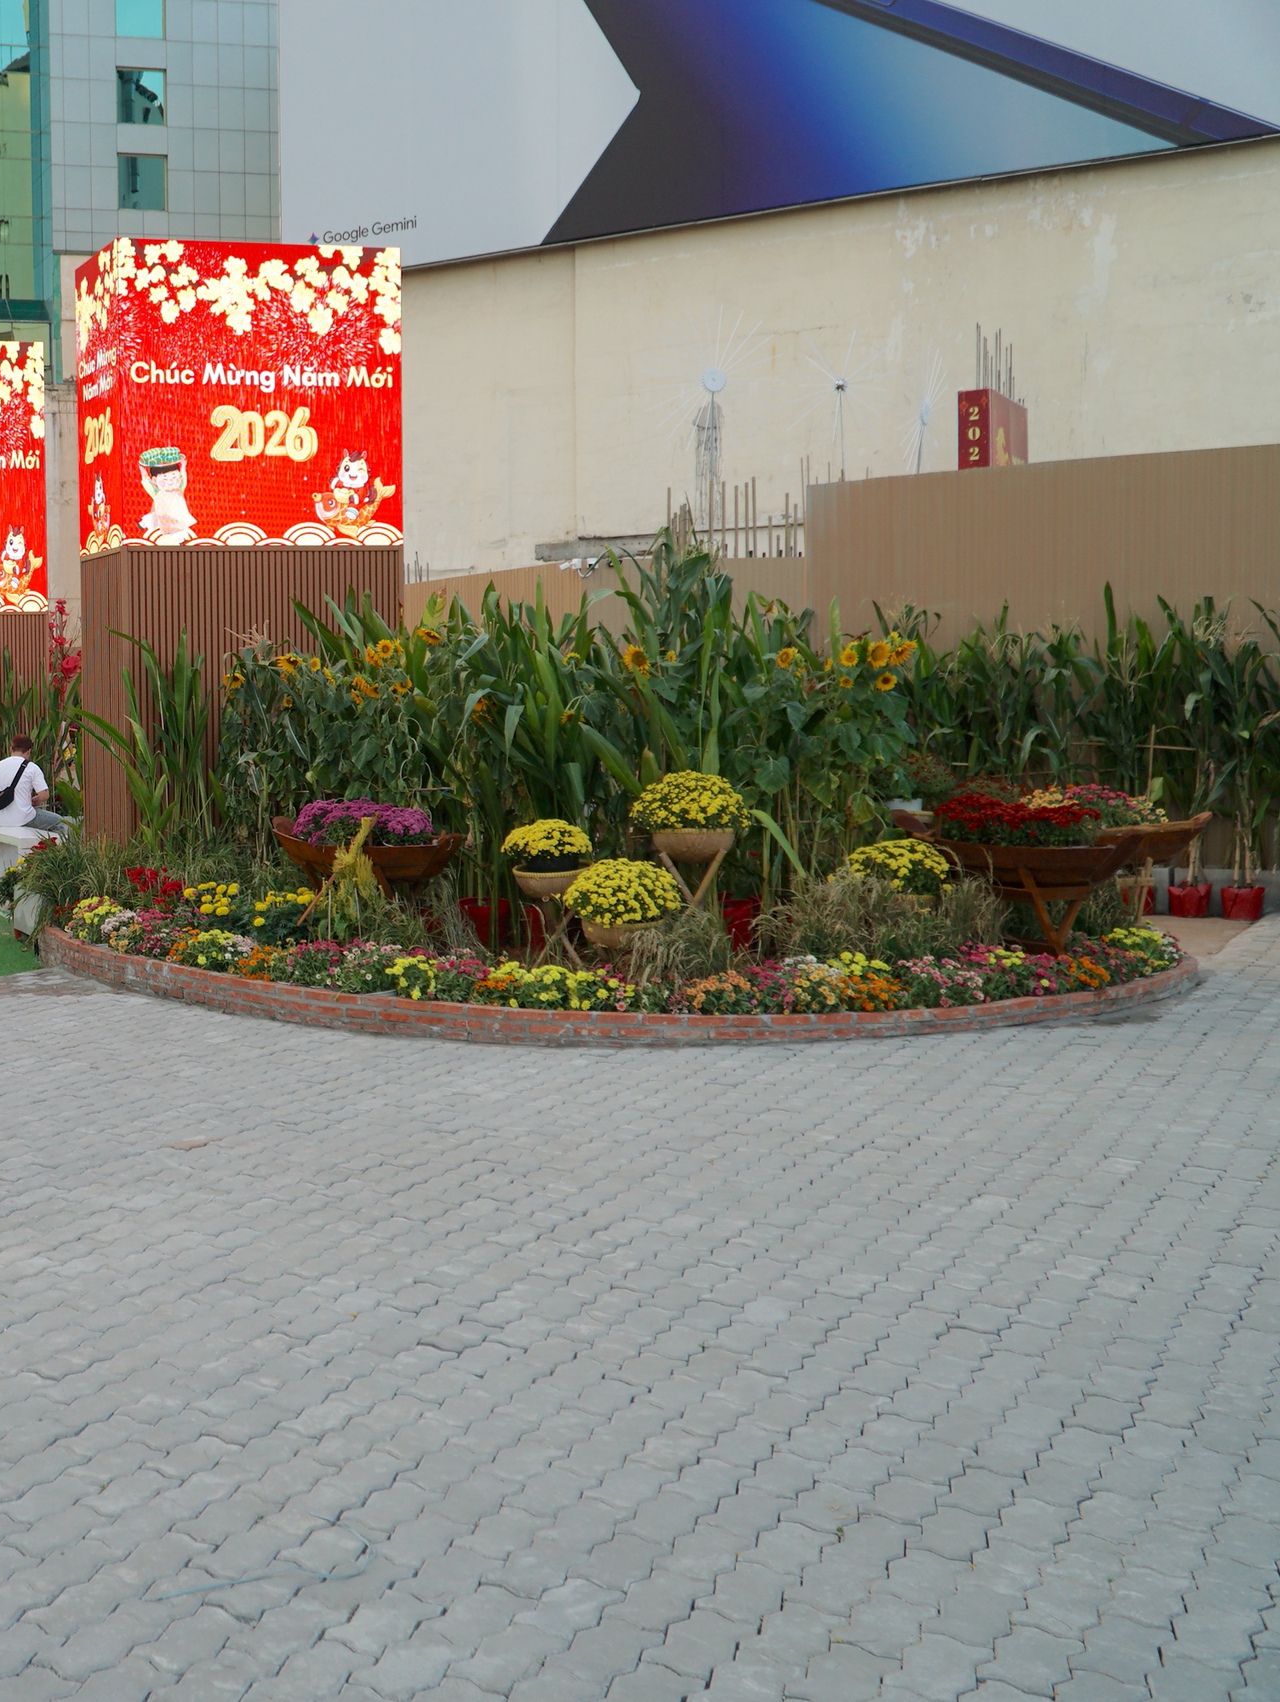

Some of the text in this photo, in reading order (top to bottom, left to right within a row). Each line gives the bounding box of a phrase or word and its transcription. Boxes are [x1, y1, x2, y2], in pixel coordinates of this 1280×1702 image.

[322, 215, 417, 244] Google Gemini
[130, 361, 394, 393] Chúc Mừng Năm Mới
[84, 406, 114, 465] 2026
[210, 404, 319, 463] 2026
[10, 450, 40, 469] Mới
